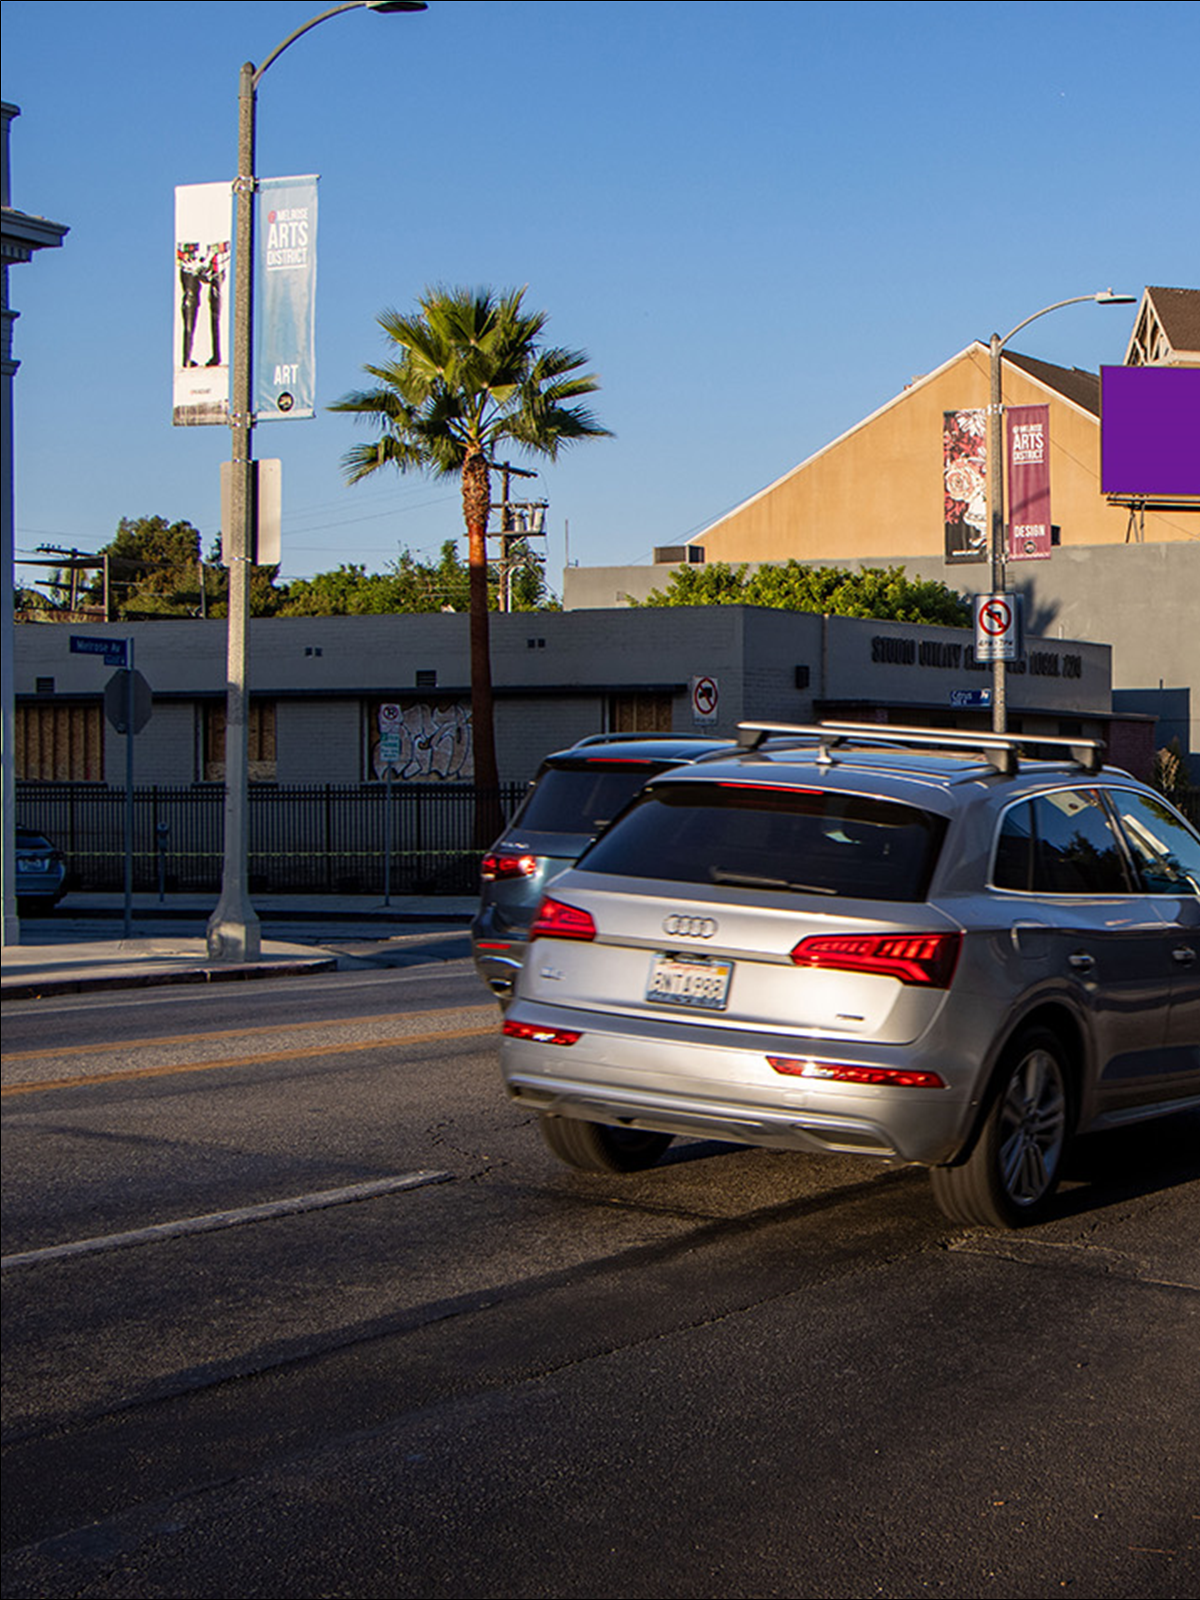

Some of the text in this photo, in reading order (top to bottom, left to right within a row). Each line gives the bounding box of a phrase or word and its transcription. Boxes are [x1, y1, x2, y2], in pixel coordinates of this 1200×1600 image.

[267, 220, 308, 249] ARTS
[267, 247, 307, 266] DISTRICT
[273, 364, 299, 385] ART
[1013, 432, 1044, 451] ARTS
[1014, 525, 1046, 538] DESIGN
[871, 636, 916, 665] STUDIO
[918, 640, 963, 668] UTILITY
